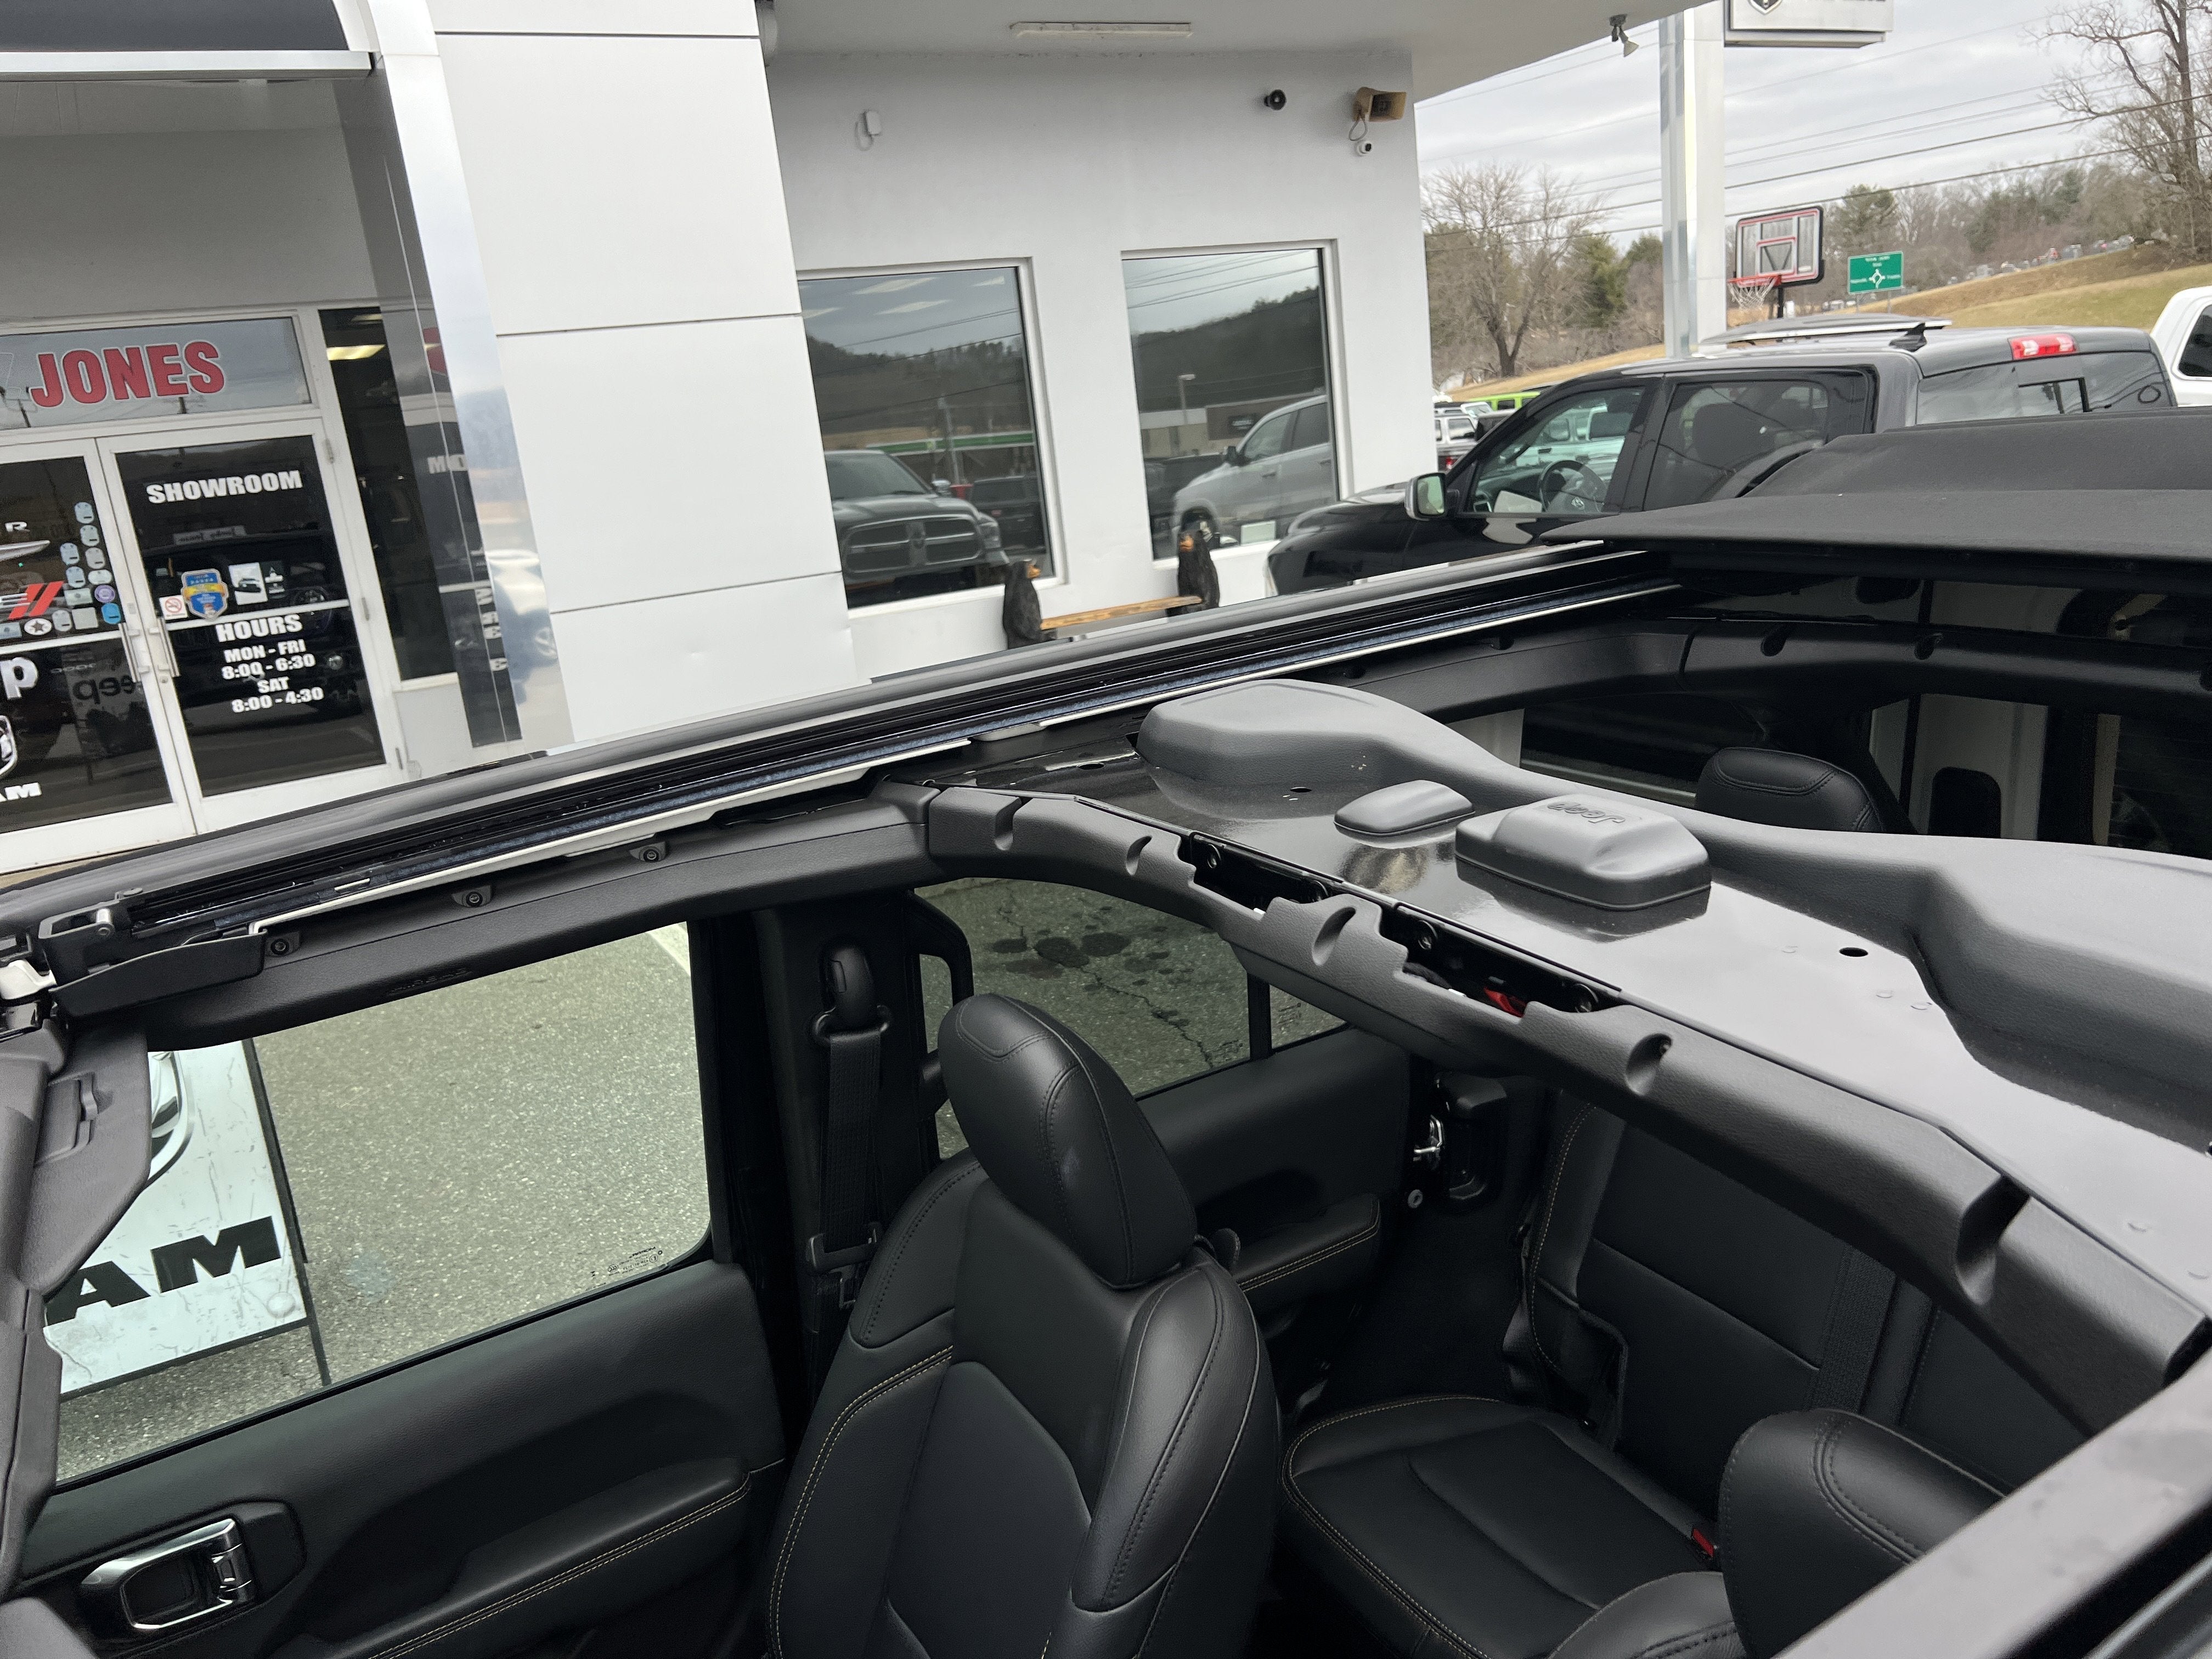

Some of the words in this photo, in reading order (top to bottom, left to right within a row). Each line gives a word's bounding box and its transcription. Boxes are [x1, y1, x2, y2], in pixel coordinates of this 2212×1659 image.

[30, 341, 224, 408] JONES
[146, 470, 303, 504] SHOWROOM
[216, 614, 303, 642] HOURS
[223, 645, 266, 663] MON
[278, 639, 307, 655] FRI
[222, 662, 264, 680] 8:00
[275, 653, 316, 672] 6:30
[257, 676, 289, 693] SAT
[232, 695, 273, 713] 8:00
[285, 687, 324, 704] 4:30
[1547, 803, 1626, 823] Jeep
[44, 1216, 282, 1327] AM
